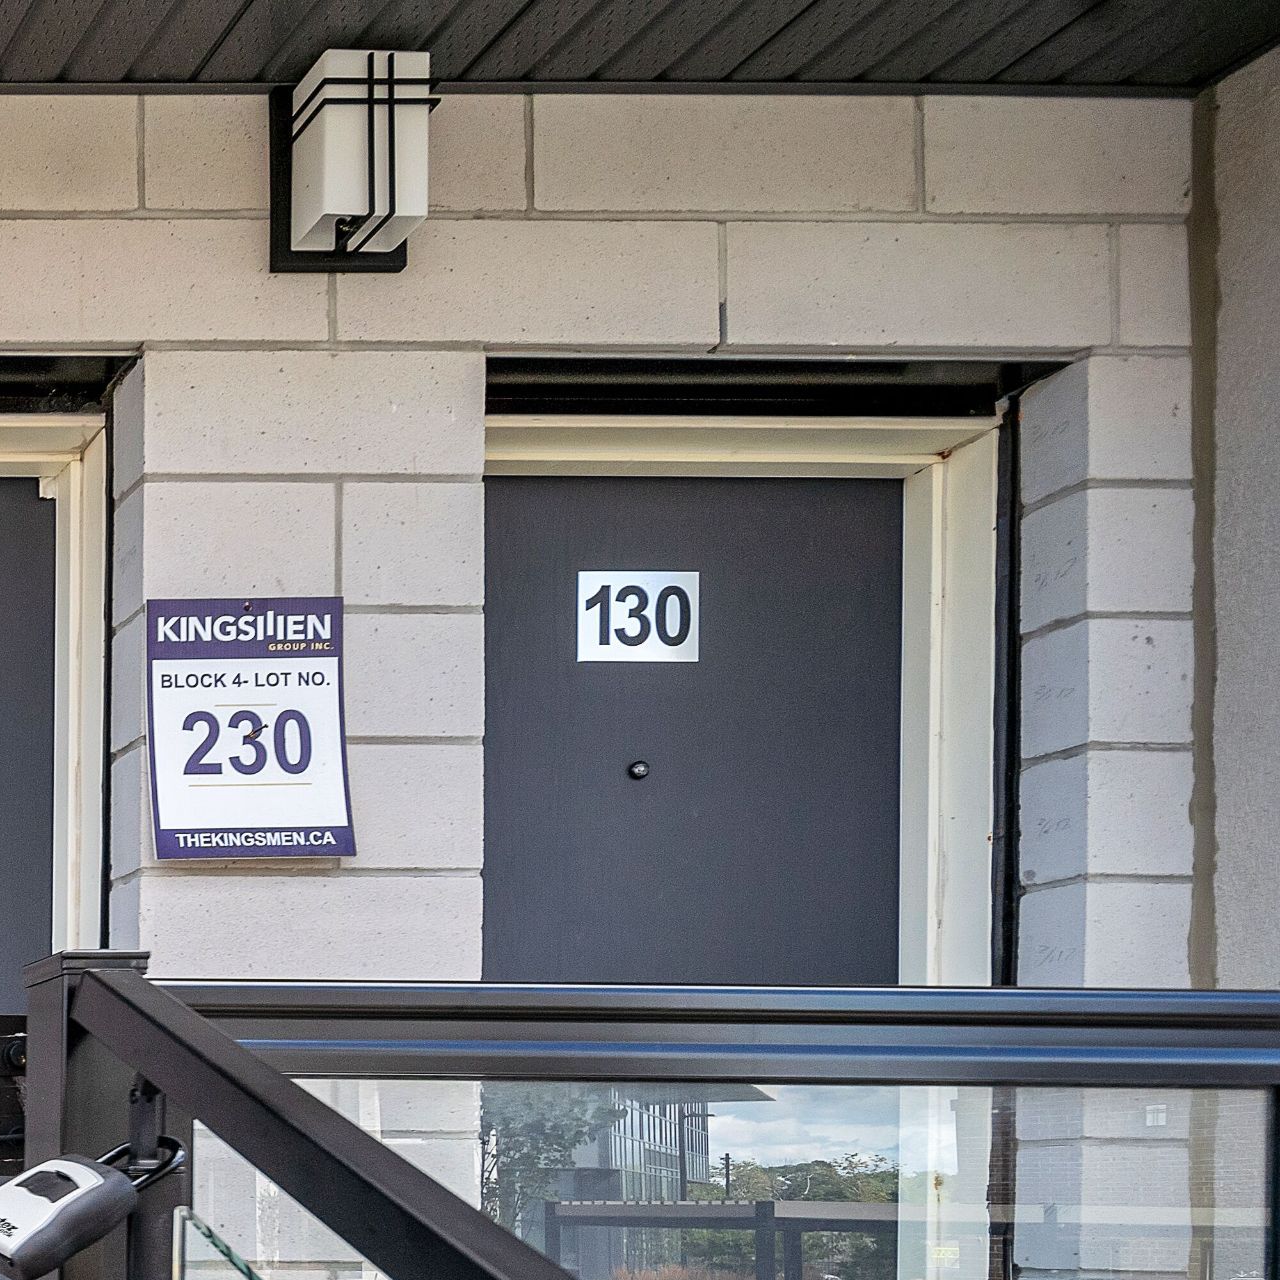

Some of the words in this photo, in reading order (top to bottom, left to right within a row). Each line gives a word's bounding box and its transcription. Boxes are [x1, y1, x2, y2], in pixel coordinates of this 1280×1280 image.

[585, 585, 691, 647] 130
[268, 643, 307, 651] GROUP
[310, 642, 335, 651] INC.
[160, 673, 227, 689] BLOCK
[254, 672, 292, 687] LOT
[298, 671, 331, 687] NO.
[181, 709, 312, 776] 230
[175, 831, 337, 849] THEKINGSMEN.CA
